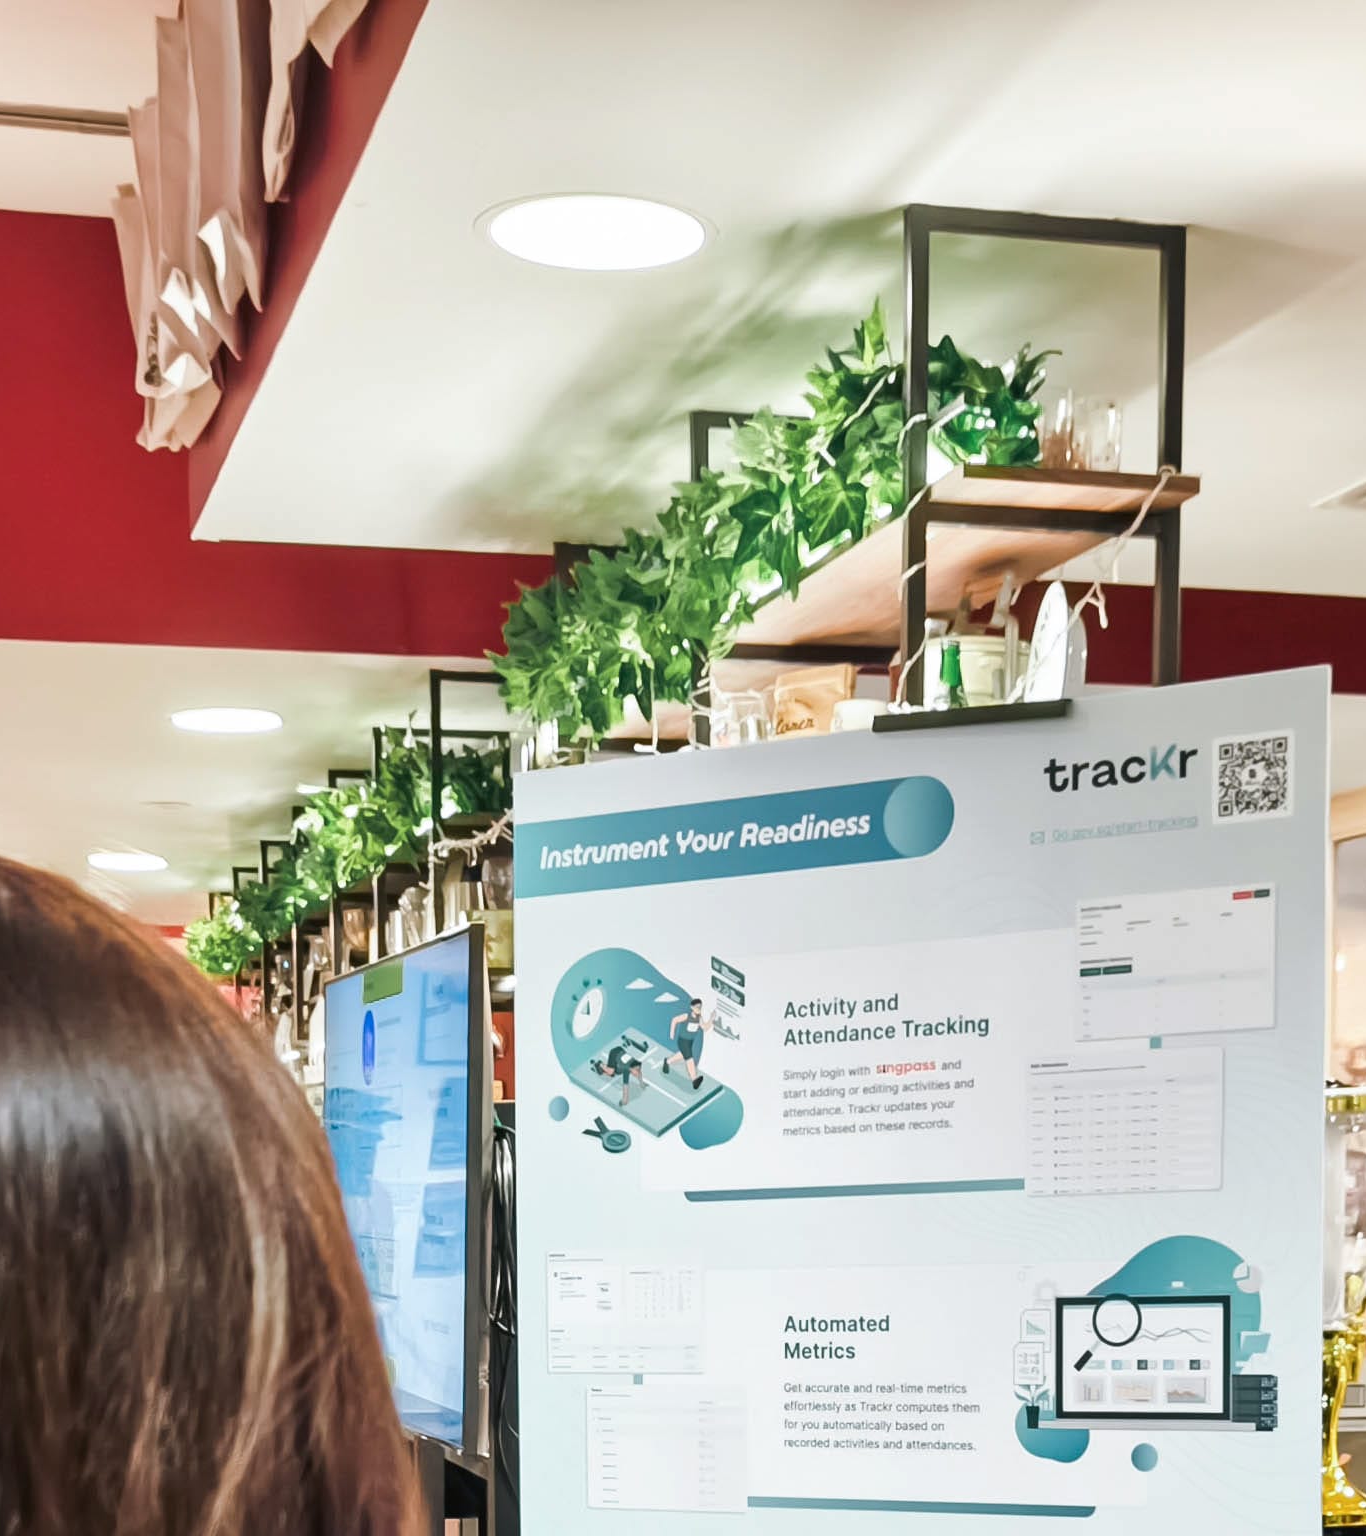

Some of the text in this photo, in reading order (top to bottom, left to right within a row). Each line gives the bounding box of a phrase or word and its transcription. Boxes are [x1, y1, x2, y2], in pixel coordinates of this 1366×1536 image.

[540, 814, 870, 870] Instrument Your Readiness
[785, 994, 899, 1018] Activity and
[784, 1016, 989, 1046] Attendance Tracking
[783, 1060, 962, 1081] Simply login with singpass and
[783, 1078, 974, 1099] start adding or editing activities and
[783, 1101, 955, 1118] attendance. Trackr updates your
[783, 1119, 953, 1136] metrics based on these records.
[785, 1315, 890, 1332] Automated
[785, 1342, 855, 1359] Metrics
[784, 1383, 967, 1394] Get accurate and real-time metrics
[784, 1401, 841, 1413] effortlessly
[860, 1402, 893, 1412] Trackr
[896, 1404, 948, 1414] computes
[952, 1404, 980, 1413] them
[784, 1420, 944, 1433] for you automatically based on
[785, 1438, 977, 1451] recorded activities and attendances.
